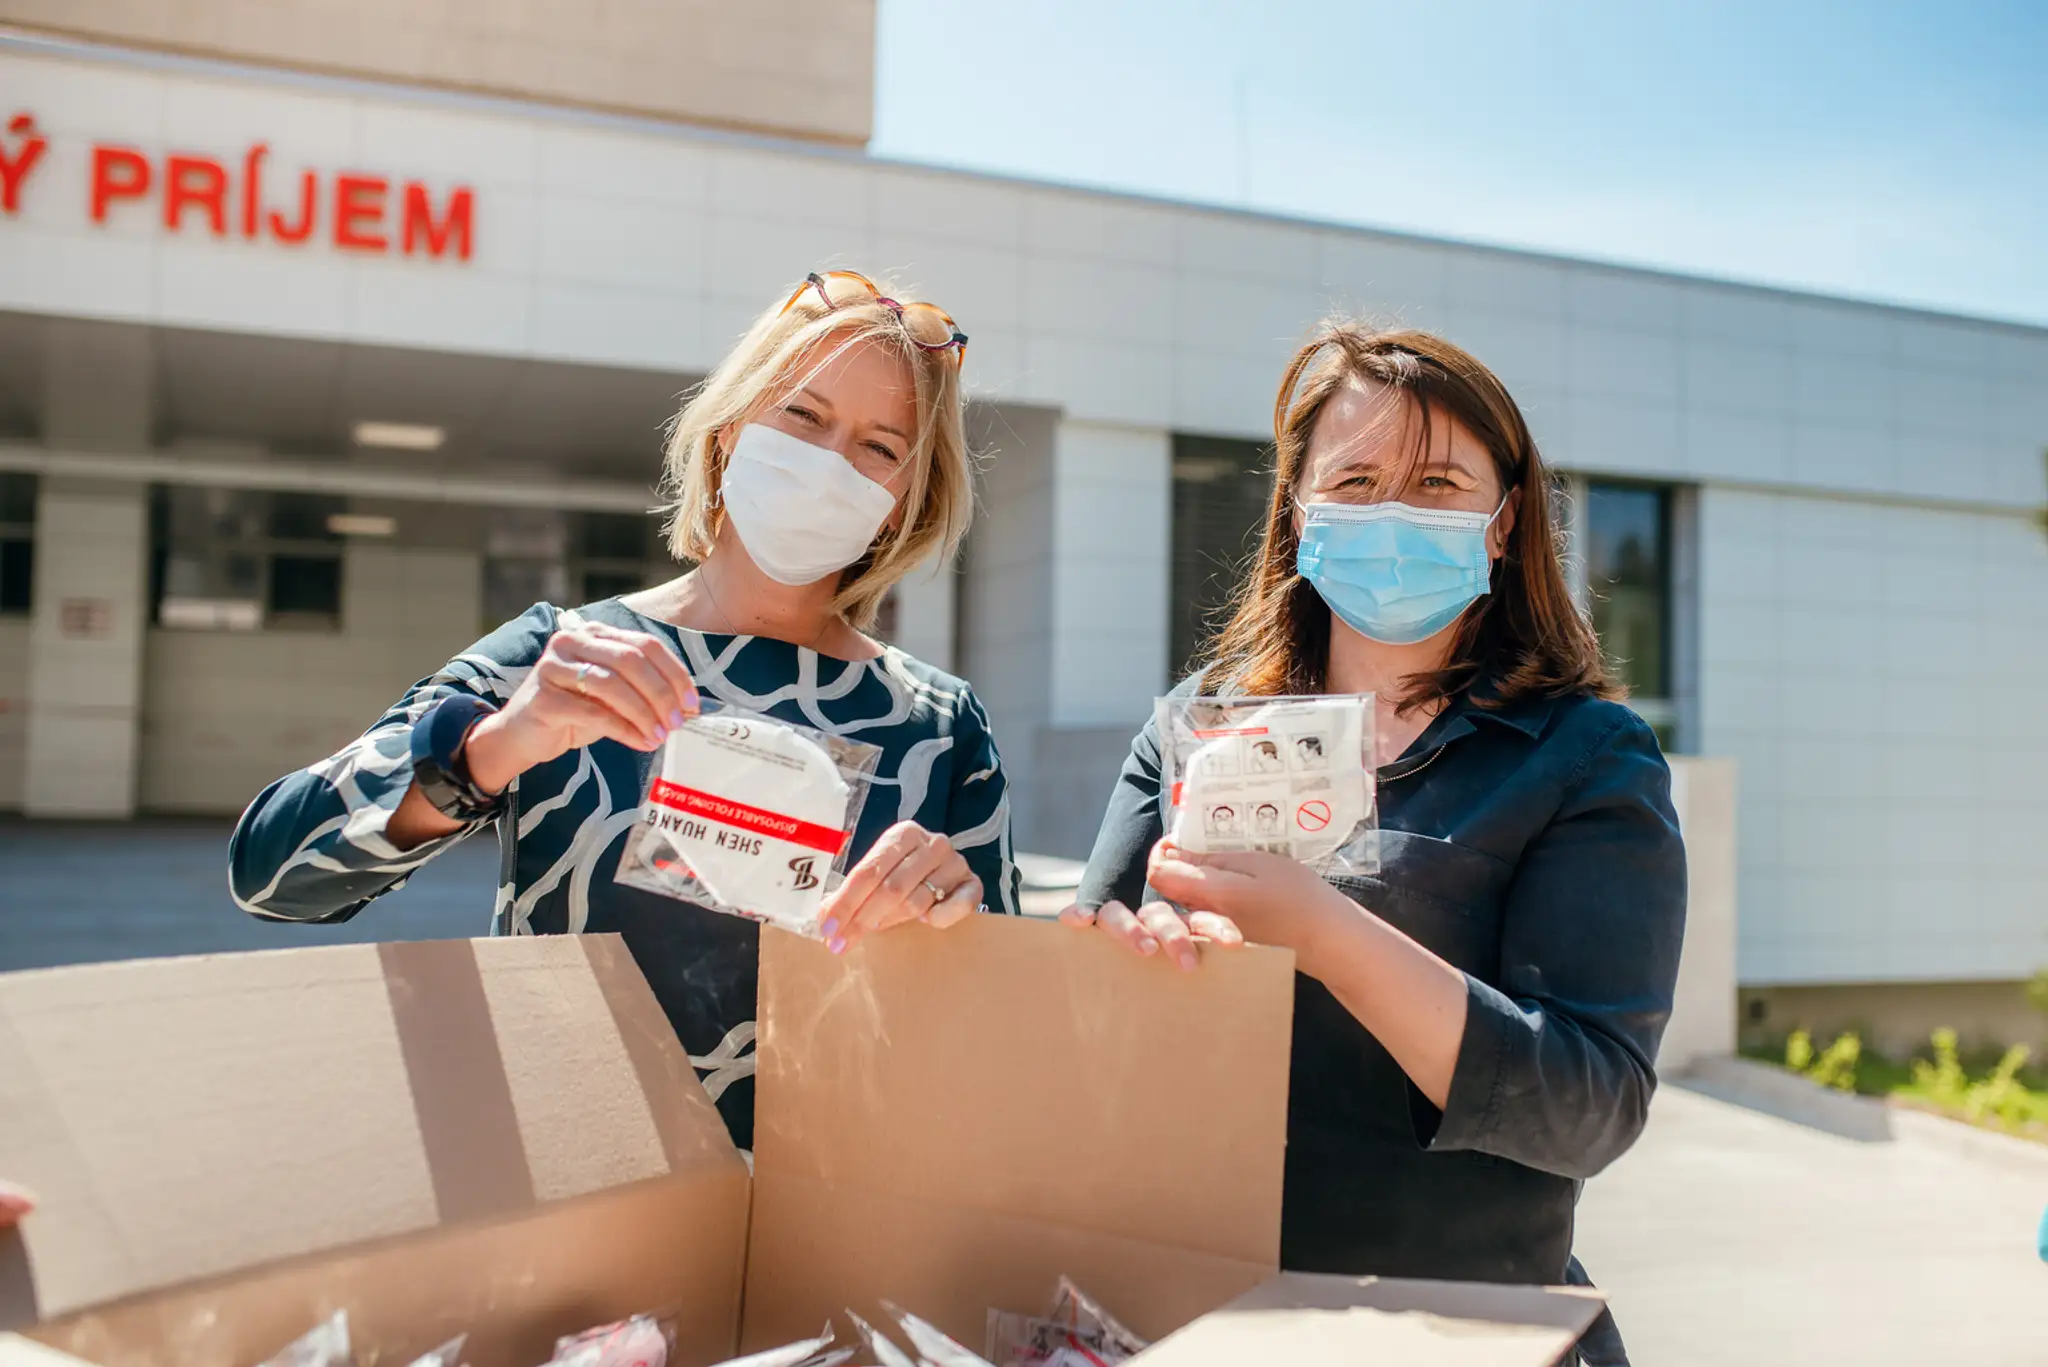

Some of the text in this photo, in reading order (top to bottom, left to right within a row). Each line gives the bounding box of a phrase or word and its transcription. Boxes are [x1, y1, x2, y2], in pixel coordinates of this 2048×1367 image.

[88, 143, 475, 263] PRÍJEM
[646, 809, 763, 856] SHEN HUANG
[656, 785, 798, 835] DISPOSABLE FOLDING MASK
